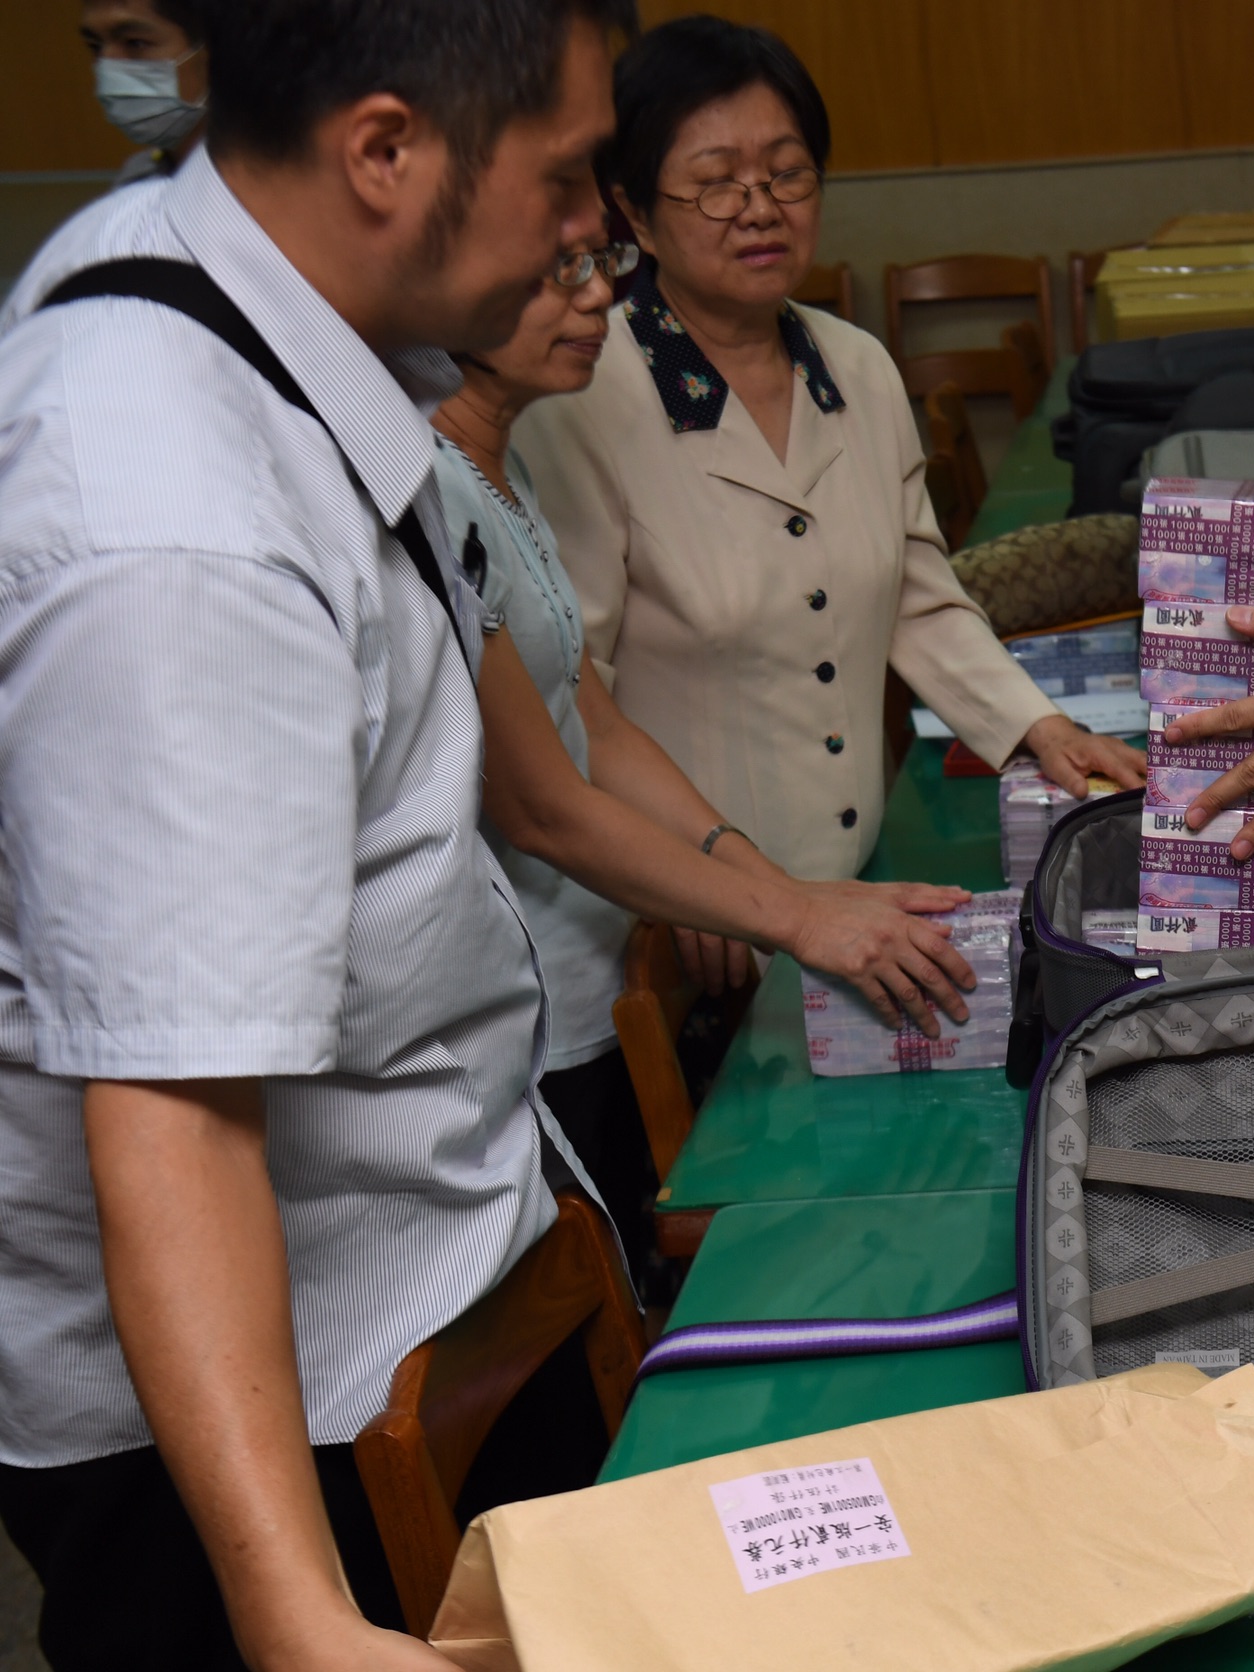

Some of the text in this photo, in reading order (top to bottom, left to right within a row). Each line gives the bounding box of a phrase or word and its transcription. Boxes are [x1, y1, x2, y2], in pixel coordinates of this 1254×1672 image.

[1141, 518, 1168, 528] 000張
[1223, 655, 1247, 664] 1000
[1155, 813, 1185, 832] 仟圓
[1199, 1354, 1208, 1363] IN
[1210, 1354, 1235, 1362] MADE
[754, 1539, 899, 1580] 中華民國 中央銀行
